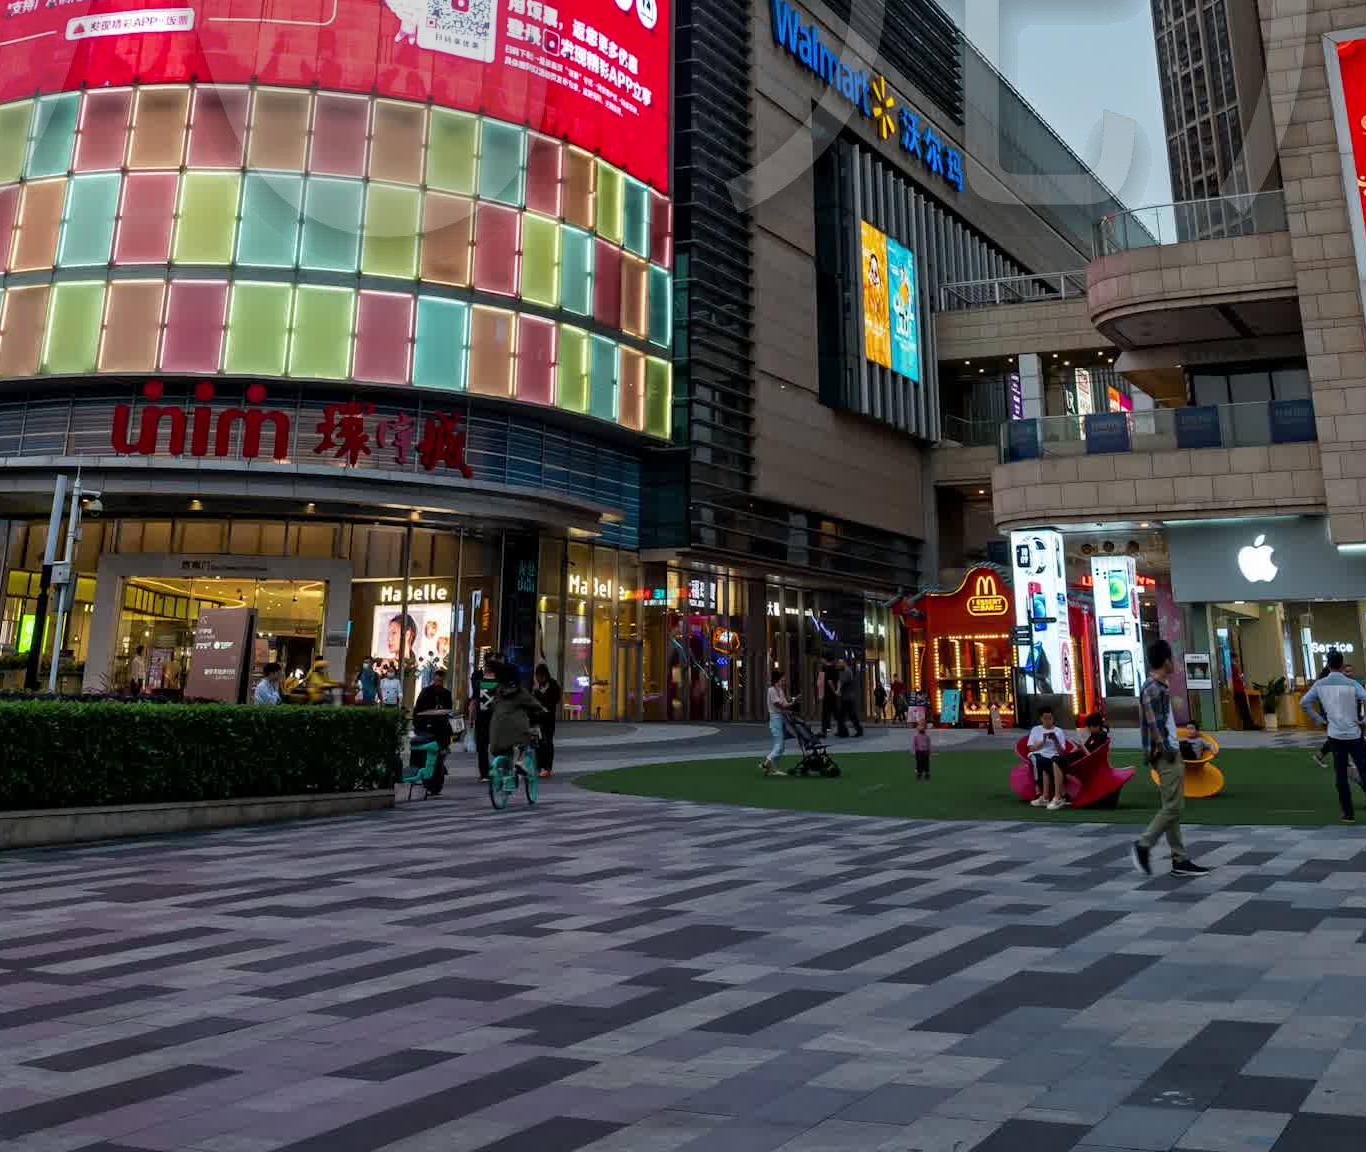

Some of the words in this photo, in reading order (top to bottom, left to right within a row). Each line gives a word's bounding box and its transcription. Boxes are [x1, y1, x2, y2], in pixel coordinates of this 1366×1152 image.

[506, 16, 542, 48] 登录
[899, 106, 965, 193] 沃尔玛
[567, 574, 626, 601] Maele
